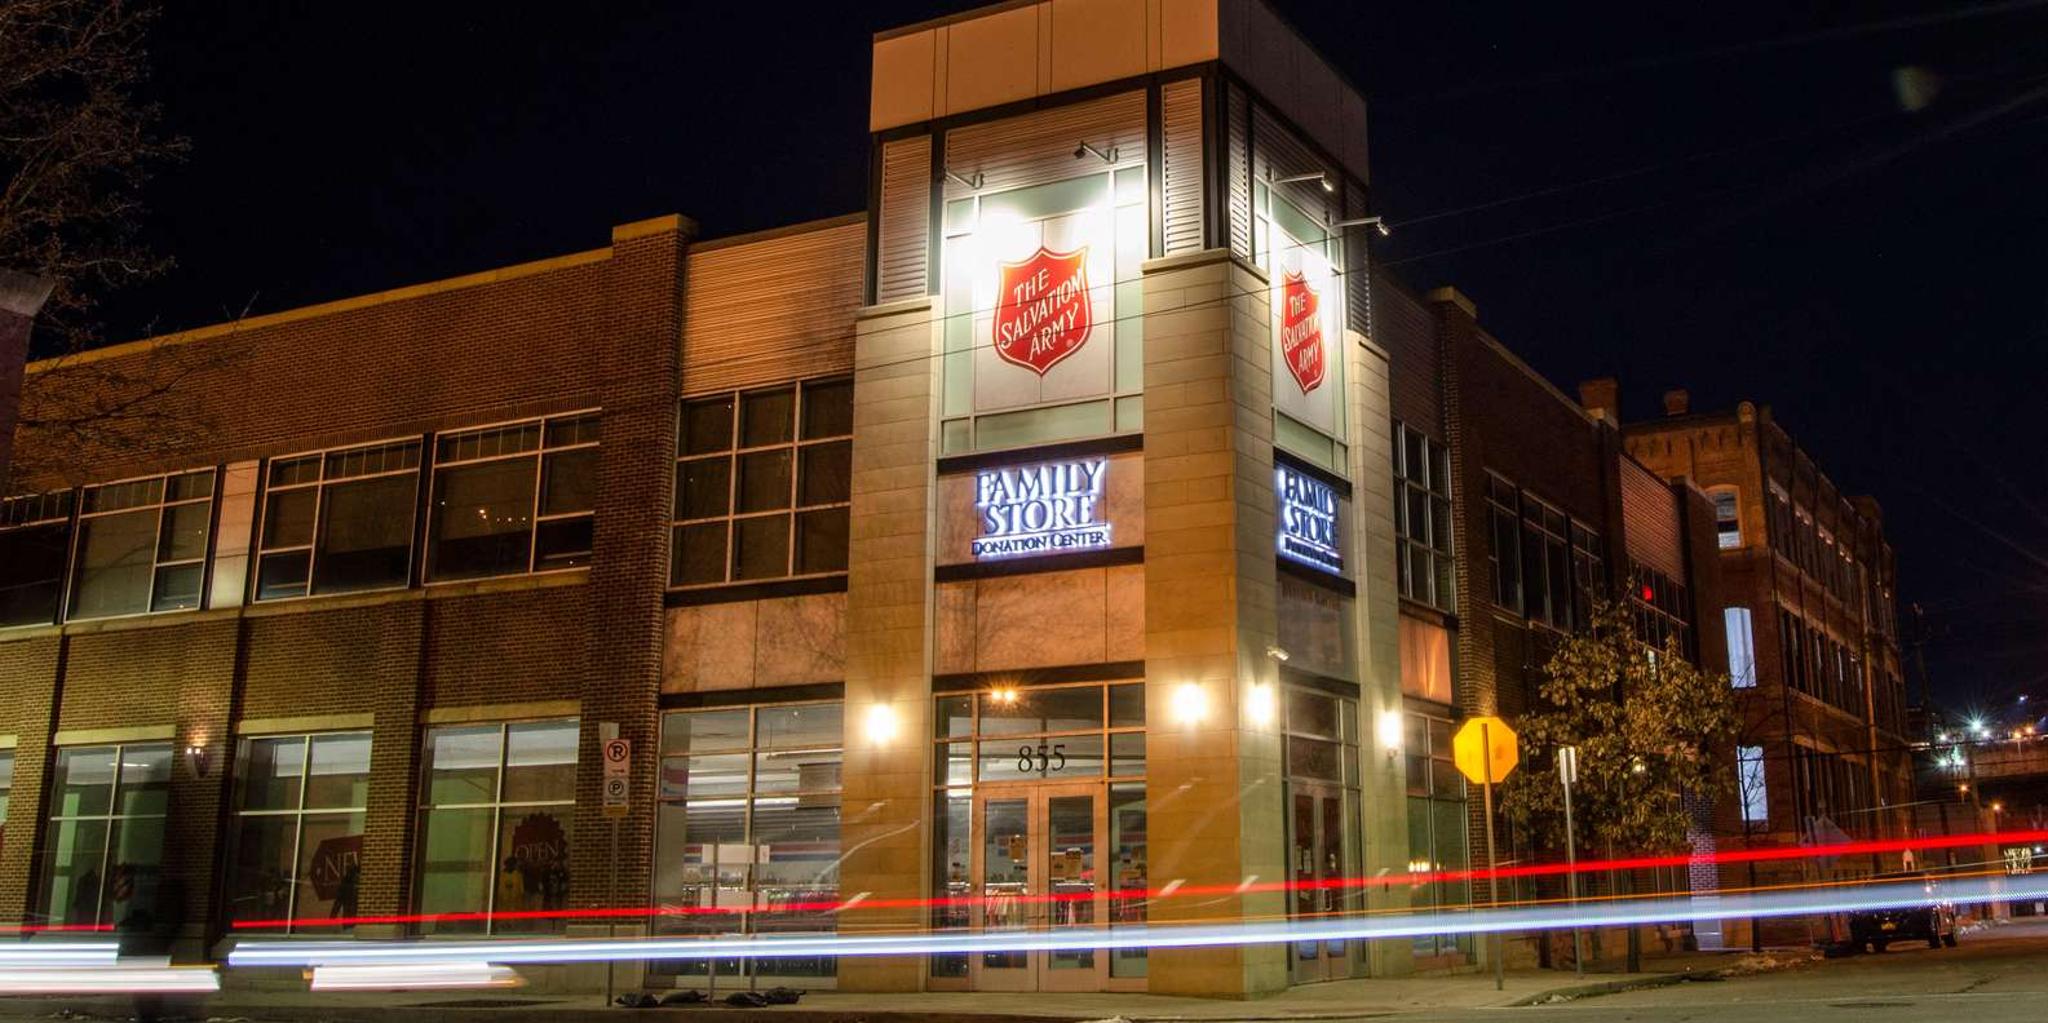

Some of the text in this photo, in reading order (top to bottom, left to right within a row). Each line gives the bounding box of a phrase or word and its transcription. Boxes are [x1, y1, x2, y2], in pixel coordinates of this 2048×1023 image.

[1014, 268, 1050, 308] THE
[1289, 292, 1306, 317] THE
[1000, 268, 1083, 349] SALVATION
[1029, 302, 1078, 362] ARMY
[976, 461, 1101, 504] FAMILY
[985, 496, 1093, 534] STORE
[972, 530, 1107, 556] DONATION CENTER
[1018, 744, 1065, 772] 855
